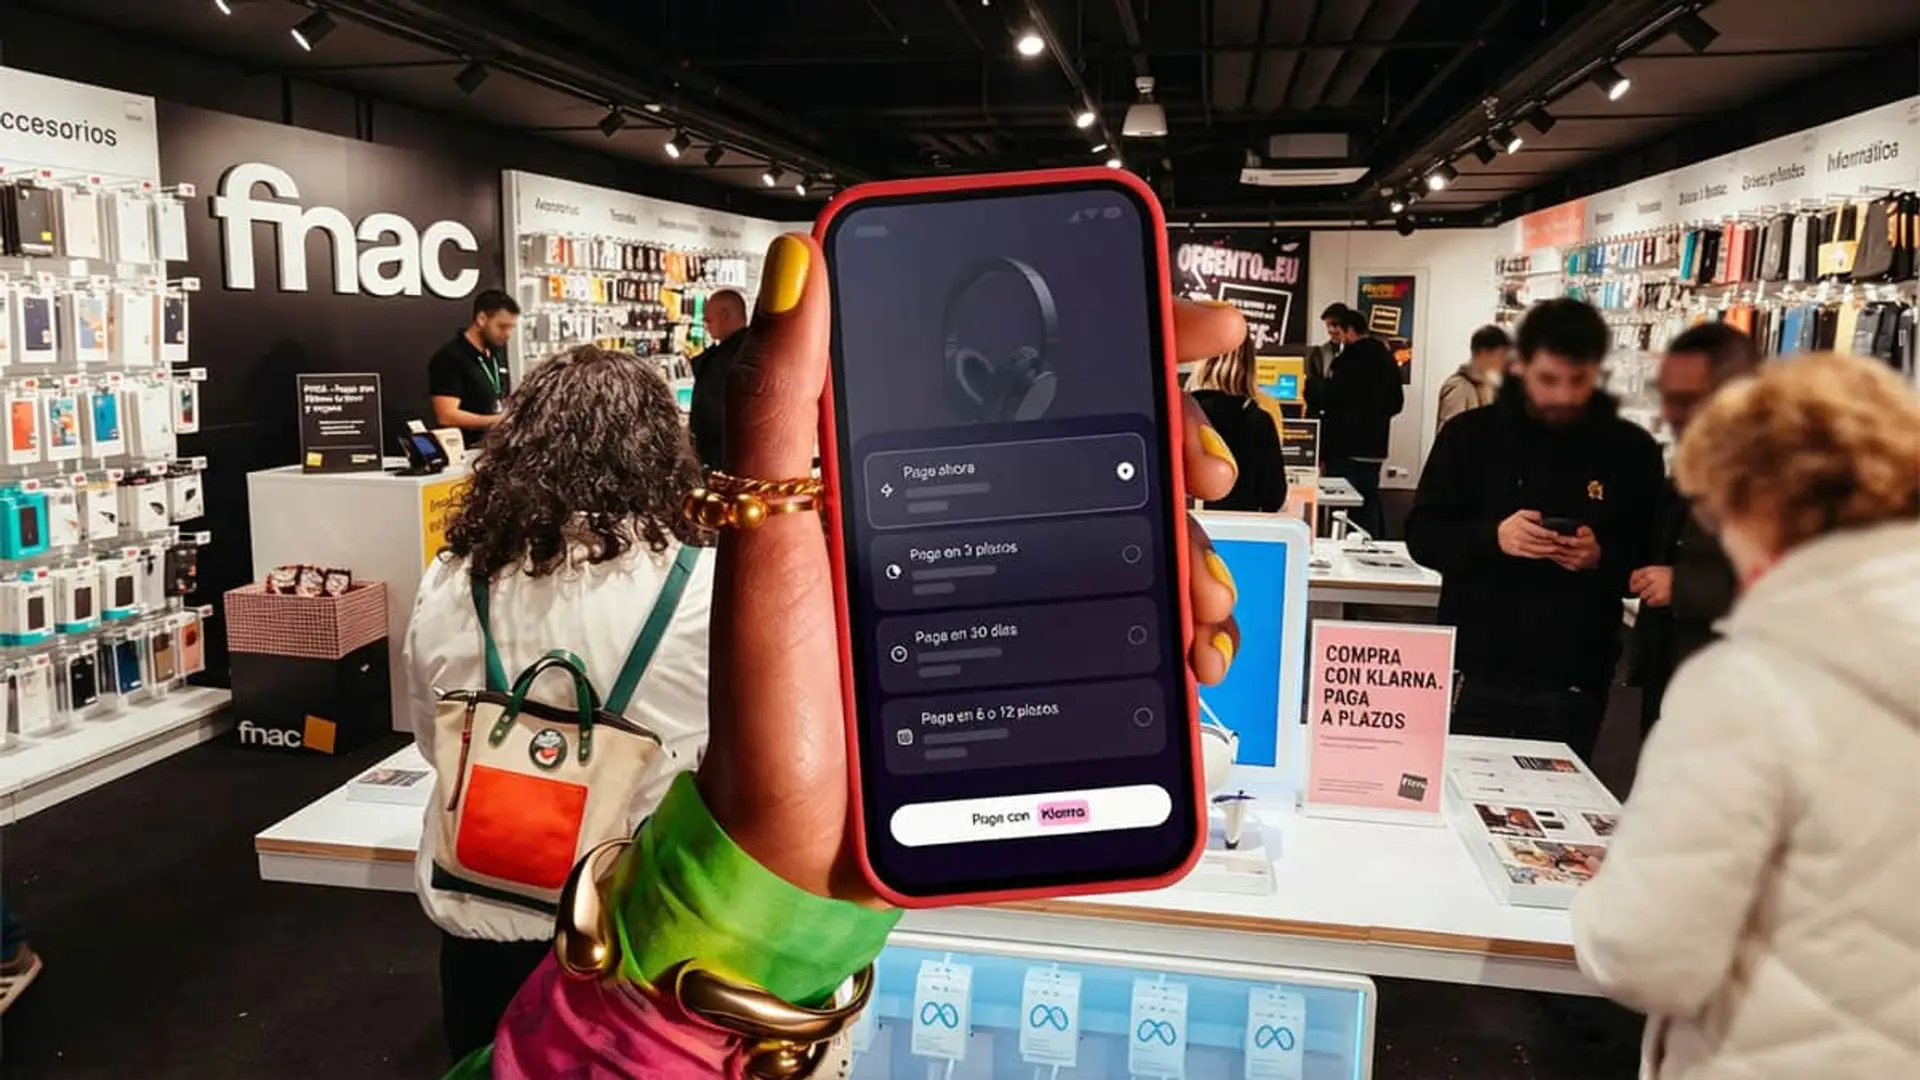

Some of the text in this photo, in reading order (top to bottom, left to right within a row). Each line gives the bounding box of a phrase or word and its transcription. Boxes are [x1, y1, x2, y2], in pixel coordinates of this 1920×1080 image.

[0, 111, 117, 147] ccesorios
[208, 162, 480, 299] fnac
[964, 543, 973, 557] 3
[971, 625, 988, 639] 30
[1326, 644, 1402, 666] COMPRA
[1325, 667, 1443, 690] CON KLARNA.
[1323, 688, 1370, 708] PAGA
[1000, 706, 1015, 719] 12
[1321, 709, 1406, 729] A PLAZOS
[238, 719, 302, 748] fnac
